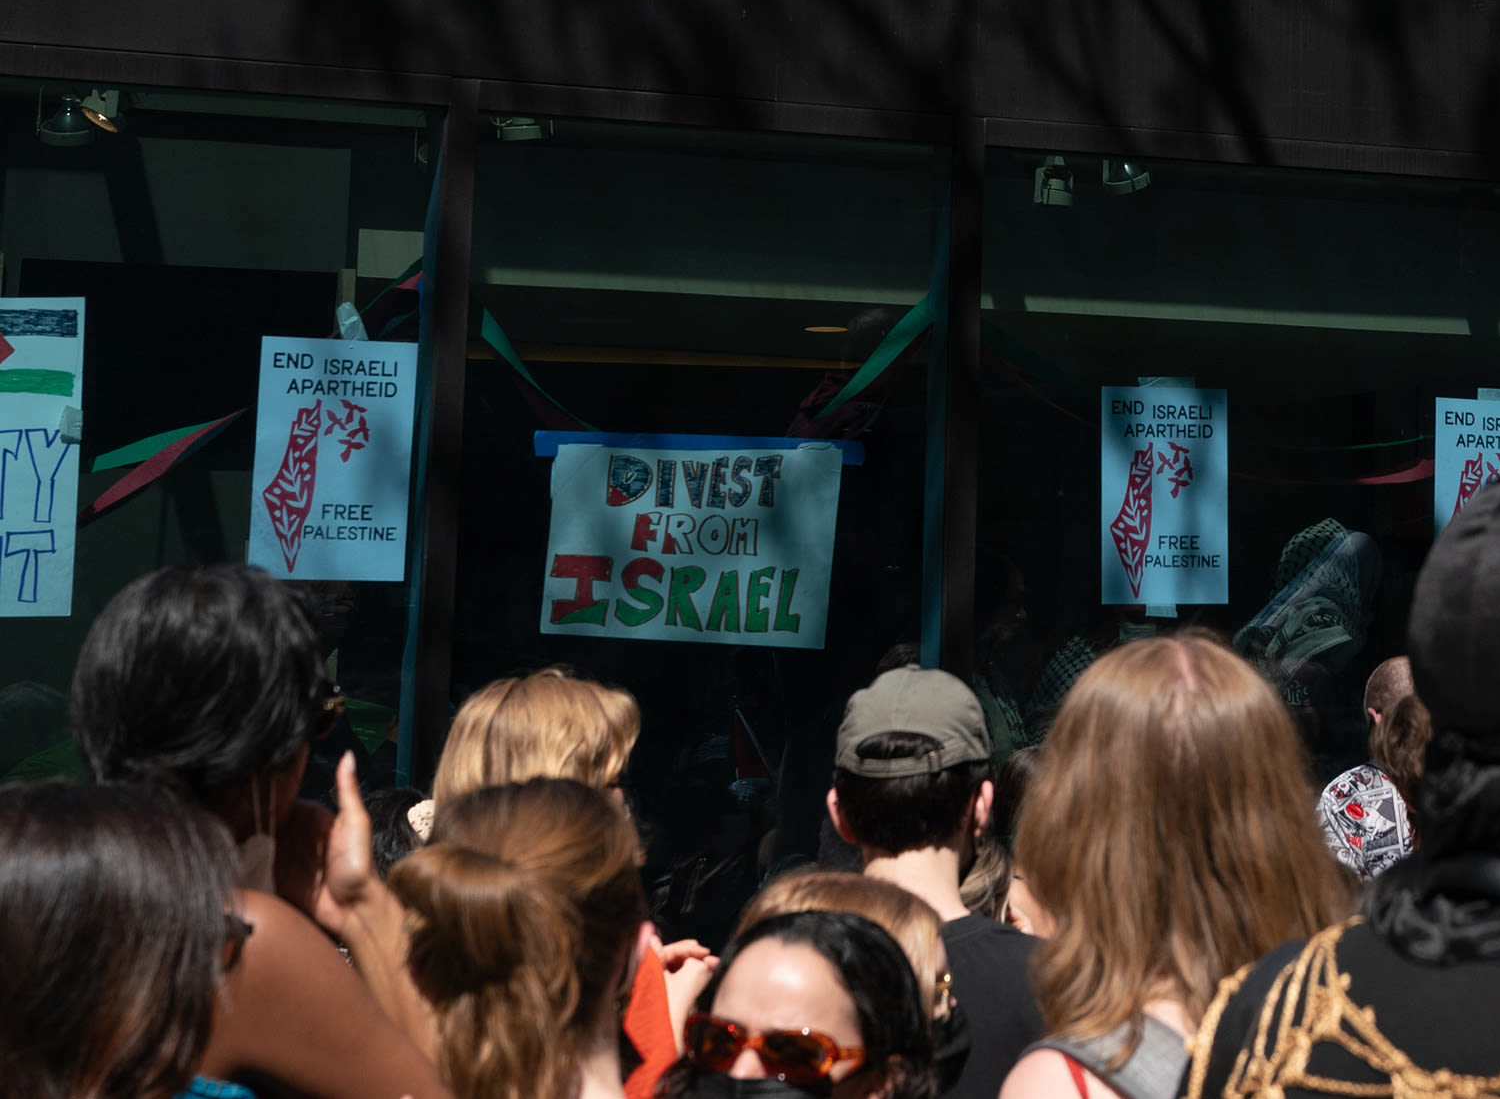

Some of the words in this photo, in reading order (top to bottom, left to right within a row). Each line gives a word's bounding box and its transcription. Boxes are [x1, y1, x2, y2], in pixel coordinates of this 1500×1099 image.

[273, 352, 313, 369] END
[324, 359, 398, 377] ISRAELI
[287, 379, 398, 398] APARTHEID
[1111, 401, 1144, 415] END
[1152, 405, 1213, 420] ISRAELI
[1445, 411, 1475, 426] END
[1124, 424, 1213, 438] APARTHEID
[606, 455, 783, 509] DIVEST
[321, 504, 373, 521] FREE
[303, 526, 397, 541] PALESTINE
[630, 512, 759, 555] FROM
[1158, 535, 1200, 550] FREE
[1145, 555, 1220, 567] PALESTINE
[550, 554, 800, 633] ISRAEL
